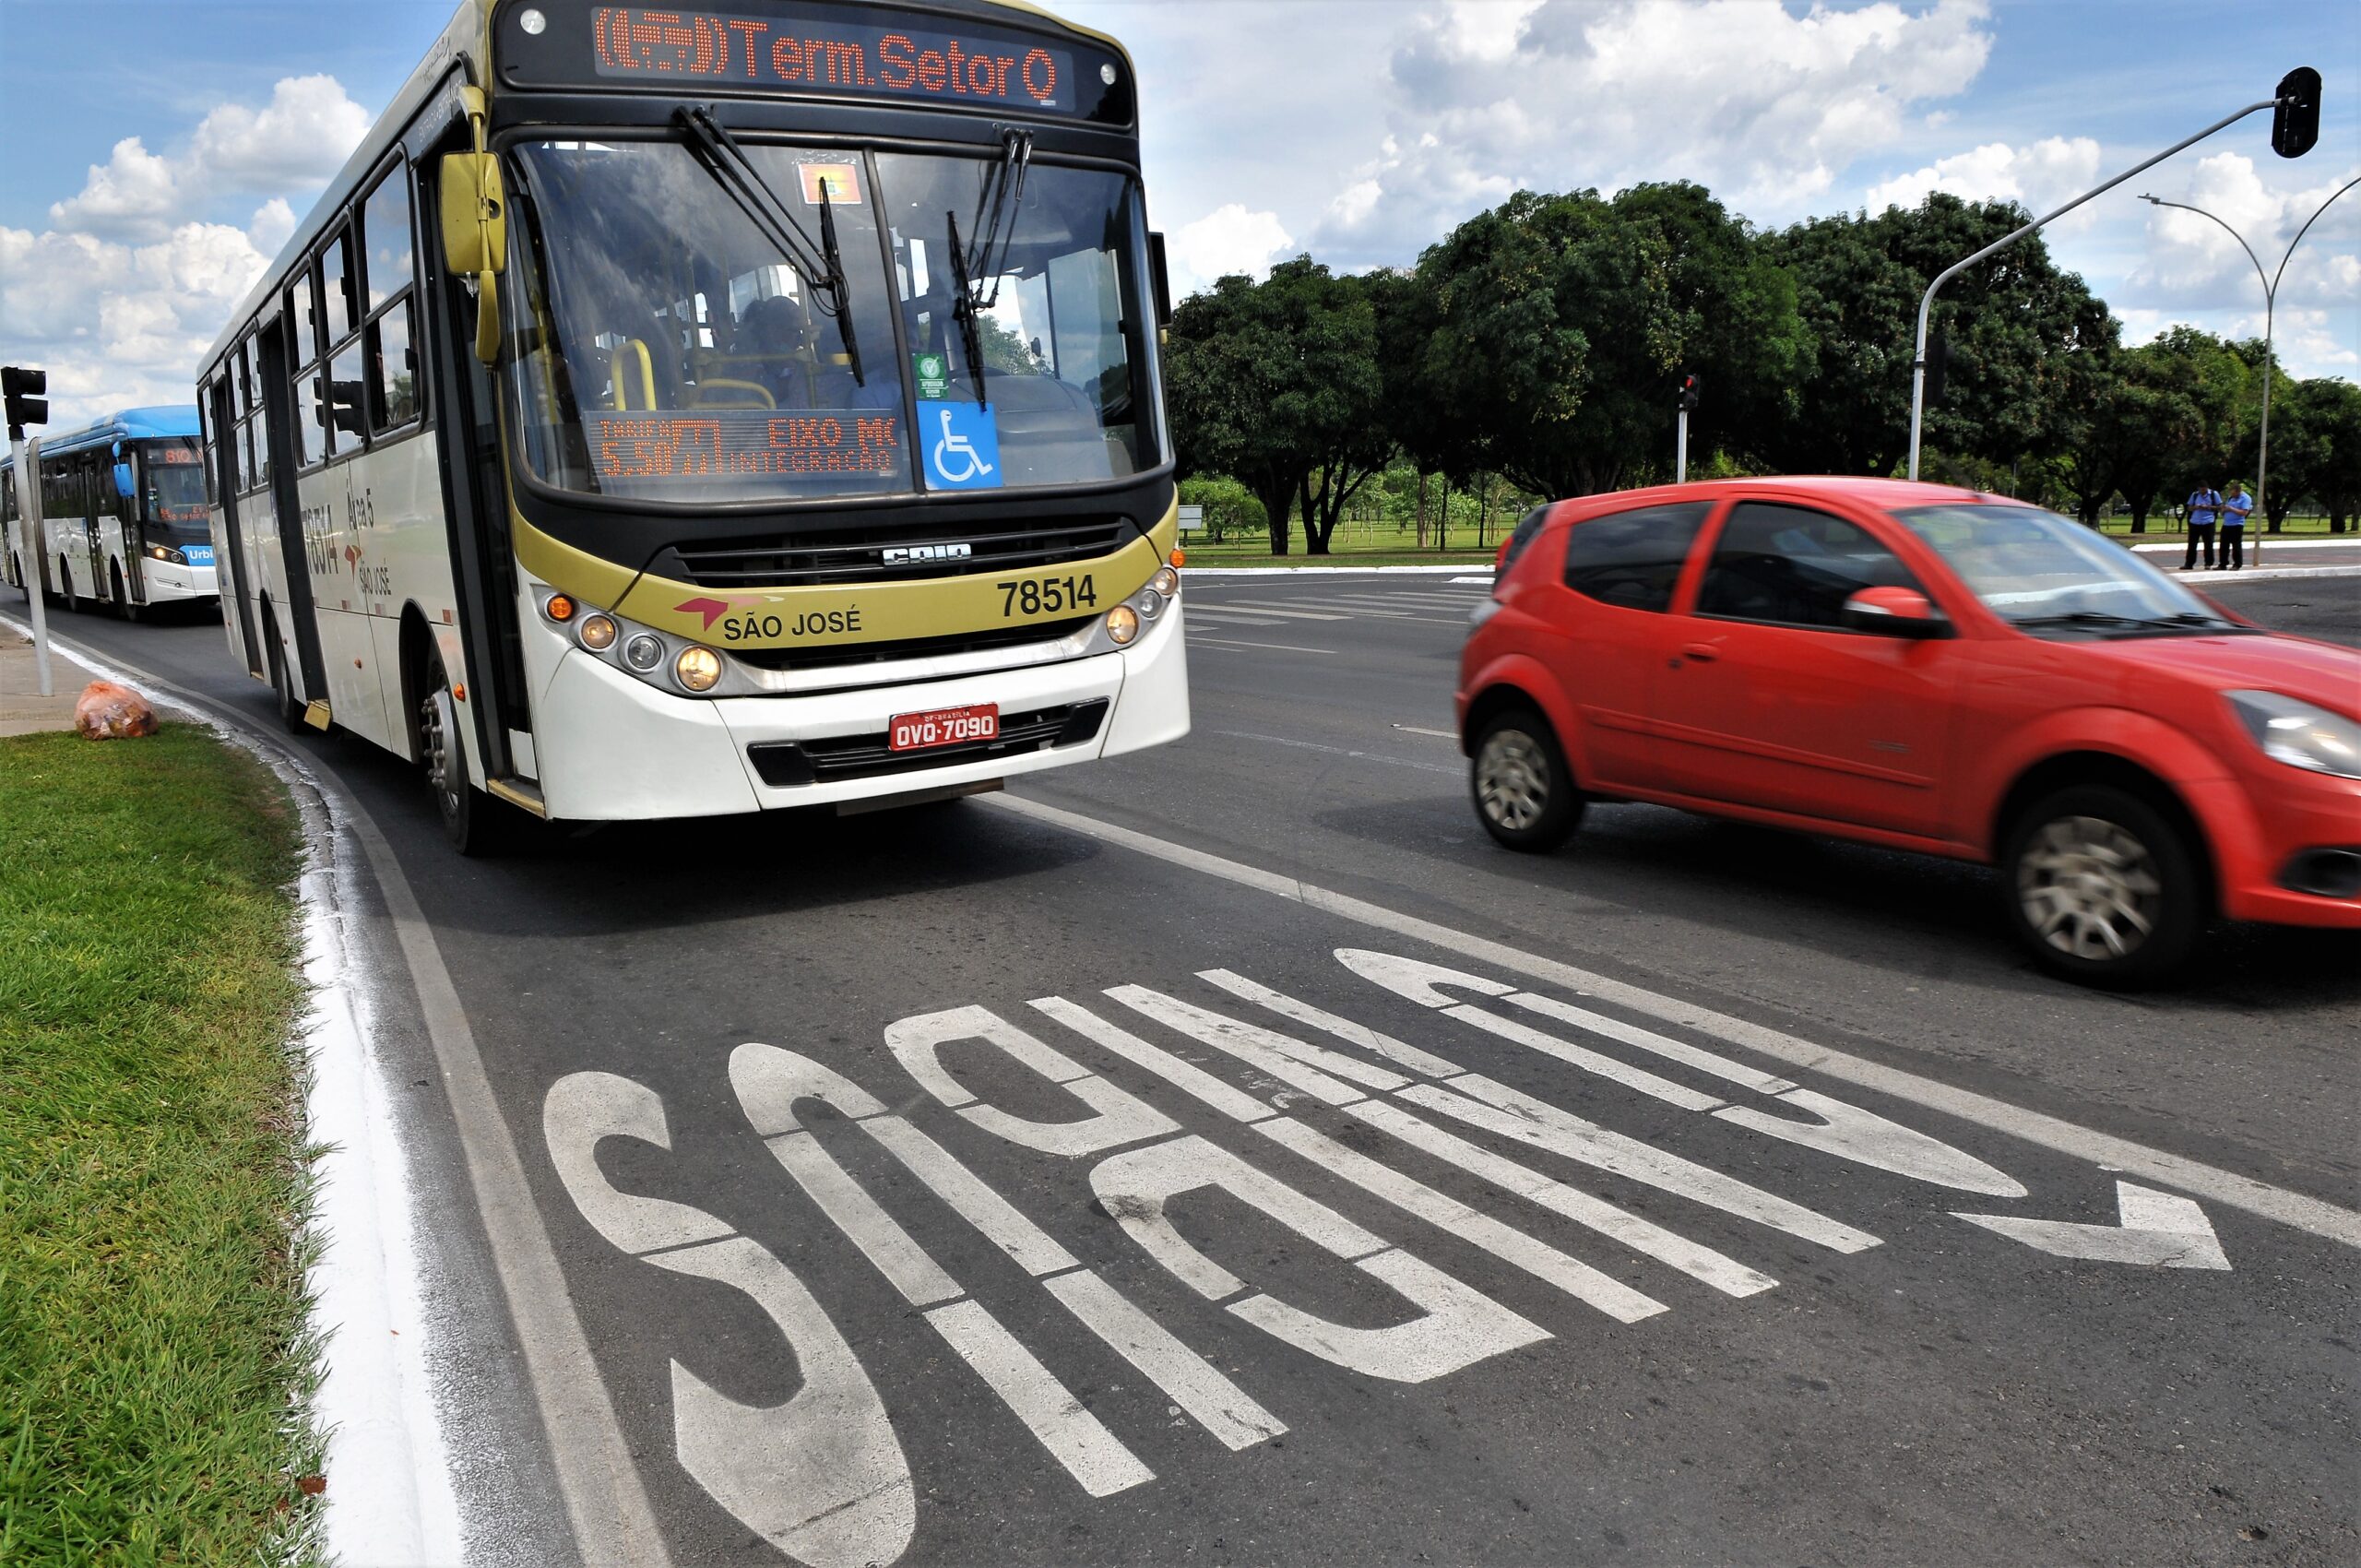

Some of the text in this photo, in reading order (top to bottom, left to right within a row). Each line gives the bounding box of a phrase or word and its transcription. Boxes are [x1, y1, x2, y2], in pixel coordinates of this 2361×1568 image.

[599, 420, 670, 438] TARIFA
[767, 417, 842, 447] EIXO
[366, 488, 374, 529] 5
[882, 543, 971, 566] CAIO
[359, 557, 392, 596] SÃO JOSÉ
[997, 574, 1097, 618] 78514
[723, 604, 862, 641] SÃO JOSÉ
